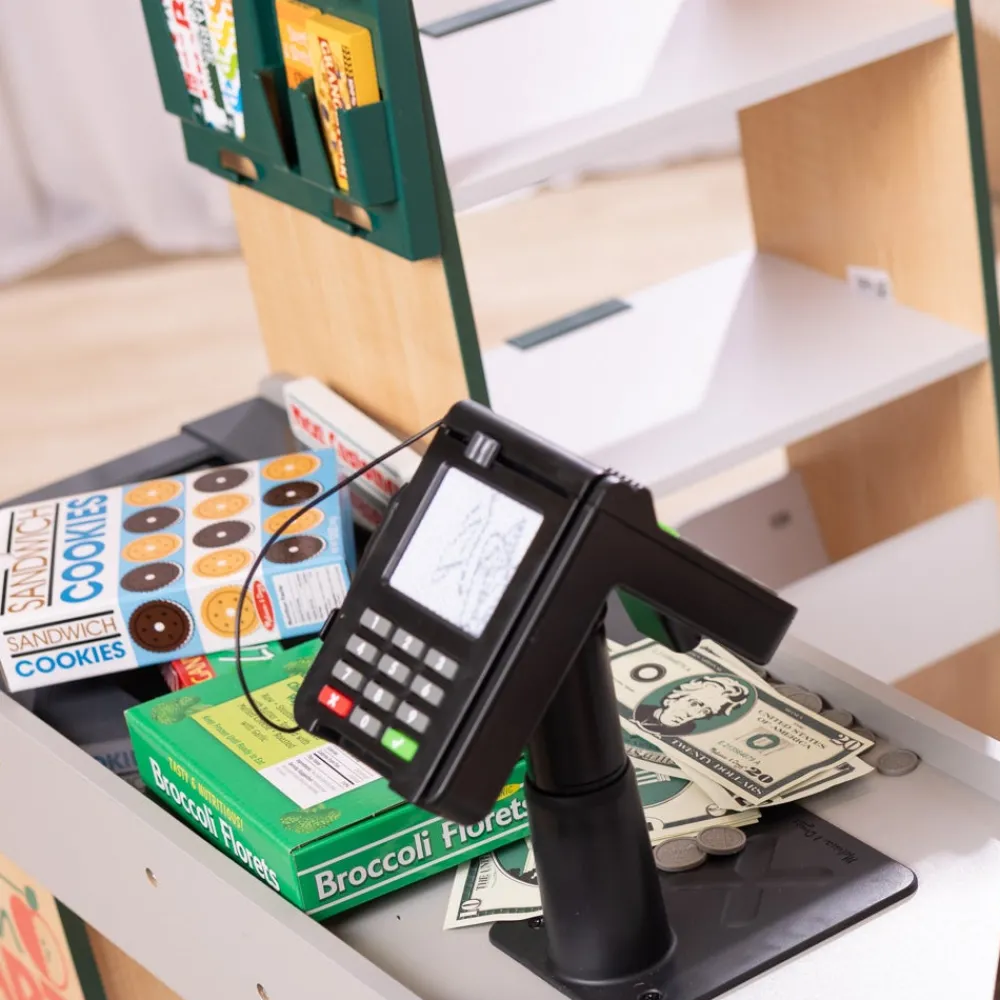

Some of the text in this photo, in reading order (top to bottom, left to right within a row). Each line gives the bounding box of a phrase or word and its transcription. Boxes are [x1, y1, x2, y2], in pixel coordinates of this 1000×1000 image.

[8, 504, 53, 614] SANDWICH
[60, 494, 108, 604] COOKIES
[7, 617, 117, 653] SANDWICH
[15, 641, 126, 678] COOKIES
[371, 615, 447, 671] 1 2 3
[341, 666, 418, 724] 7 8 9
[356, 642, 433, 697] 4 5 6
[360, 714, 371, 729] 0
[758, 710, 793, 731] UNITED
[792, 728, 827, 750] STATES
[671, 738, 712, 766] TWENTY
[713, 761, 763, 795] DOLLARS
[745, 766, 774, 783] 20
[149, 756, 219, 839] Broccoli
[218, 816, 281, 892] Florets
[314, 798, 530, 901] Broccoli Florets
[458, 899, 481, 920] 10
